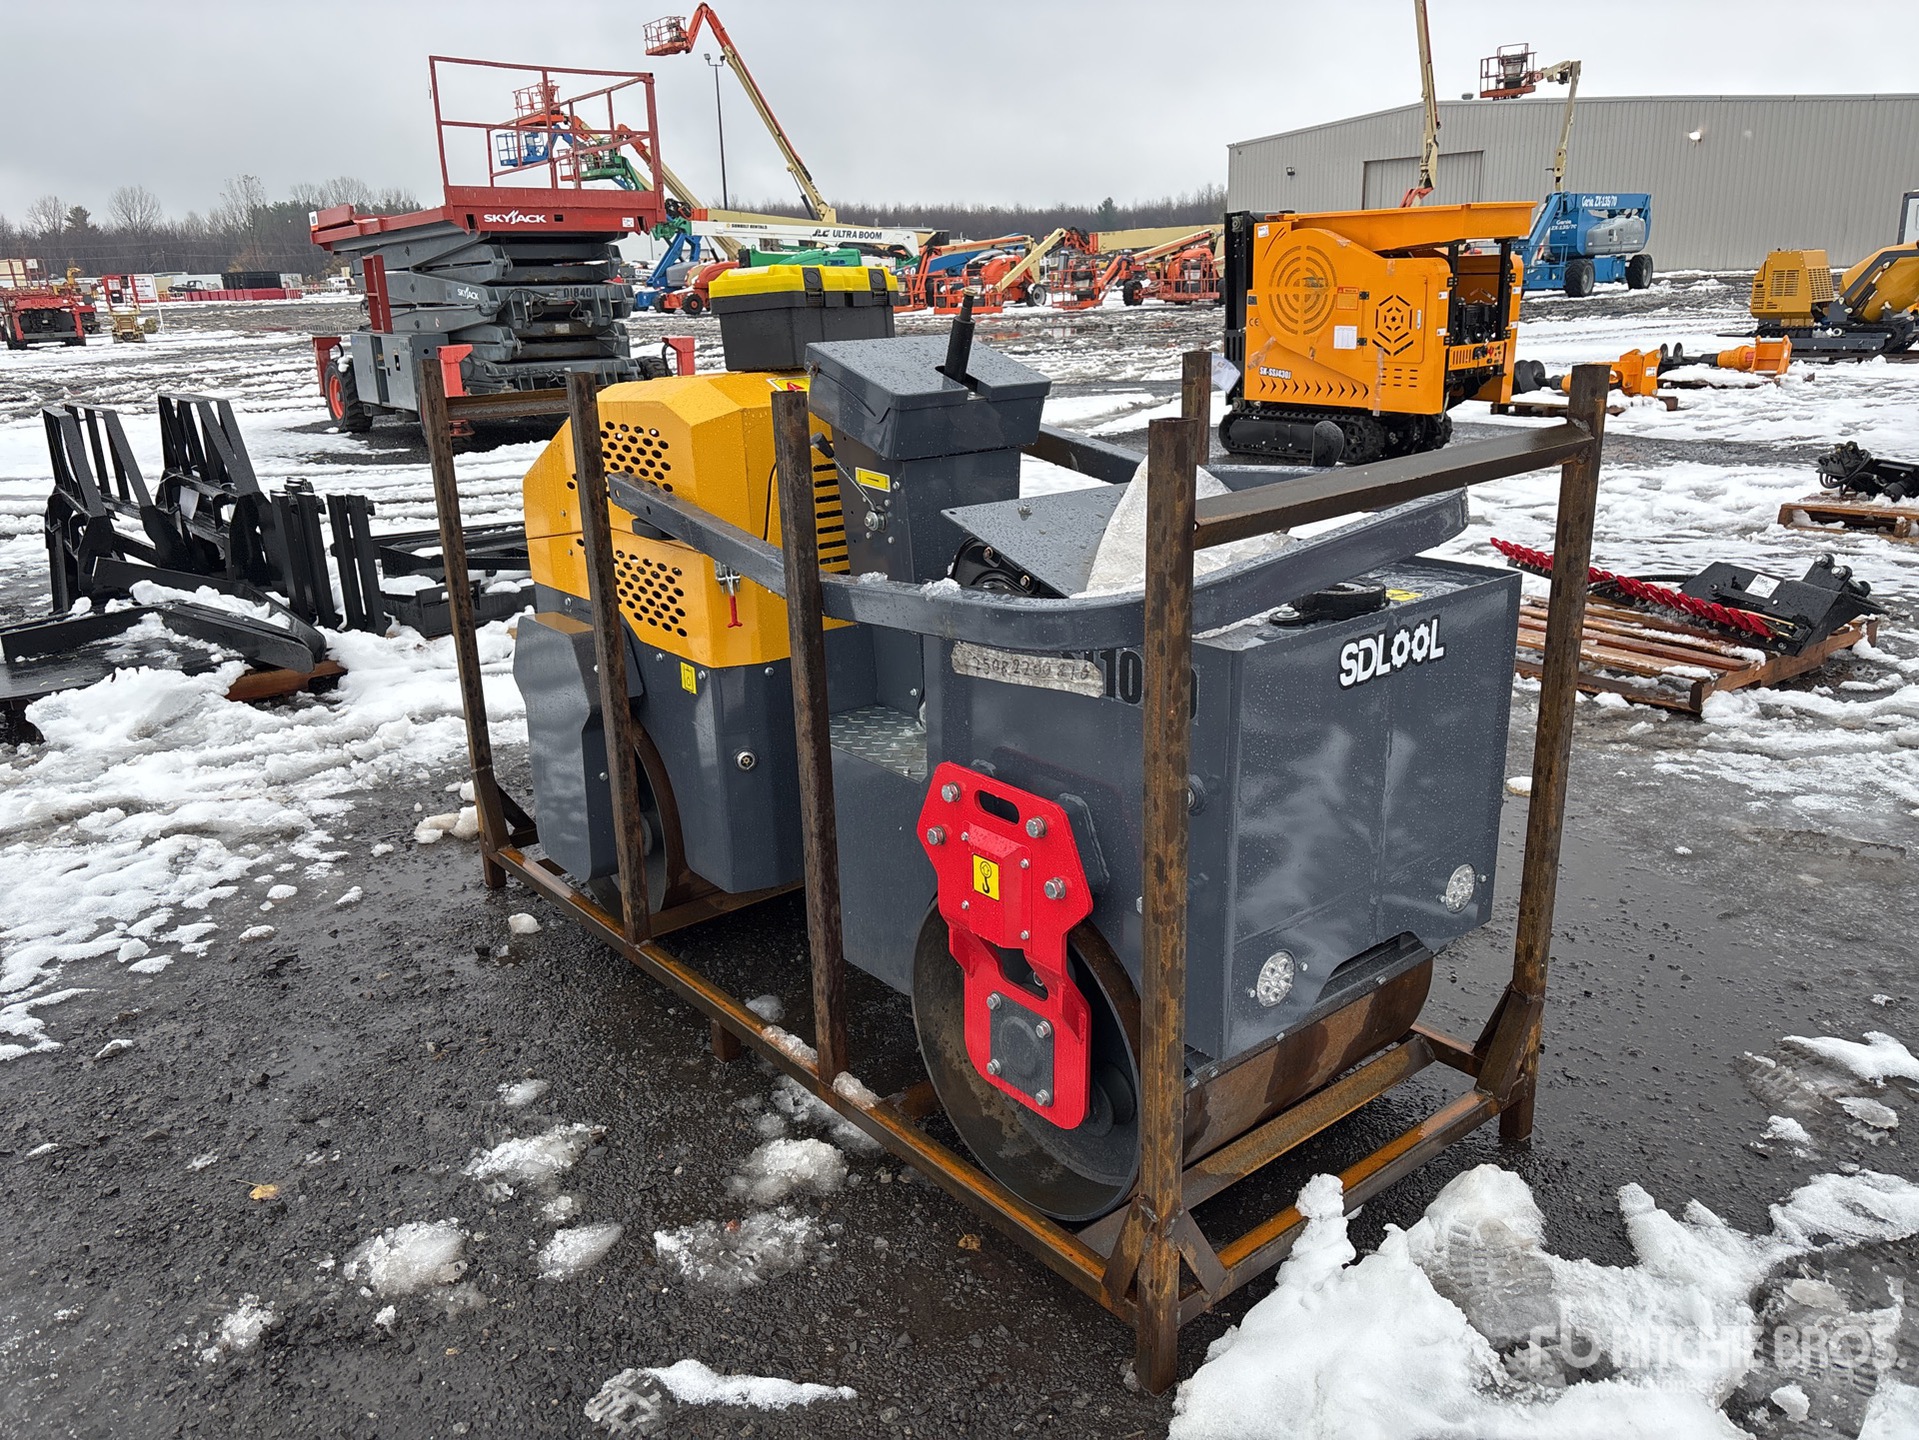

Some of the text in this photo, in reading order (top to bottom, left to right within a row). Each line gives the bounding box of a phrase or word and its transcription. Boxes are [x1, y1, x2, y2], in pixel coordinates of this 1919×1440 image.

[483, 209, 547, 225] SKYJACK
[832, 230, 857, 239] ULTRA
[858, 231, 883, 240] BOOM
[1340, 618, 1444, 687] SDLOOL
